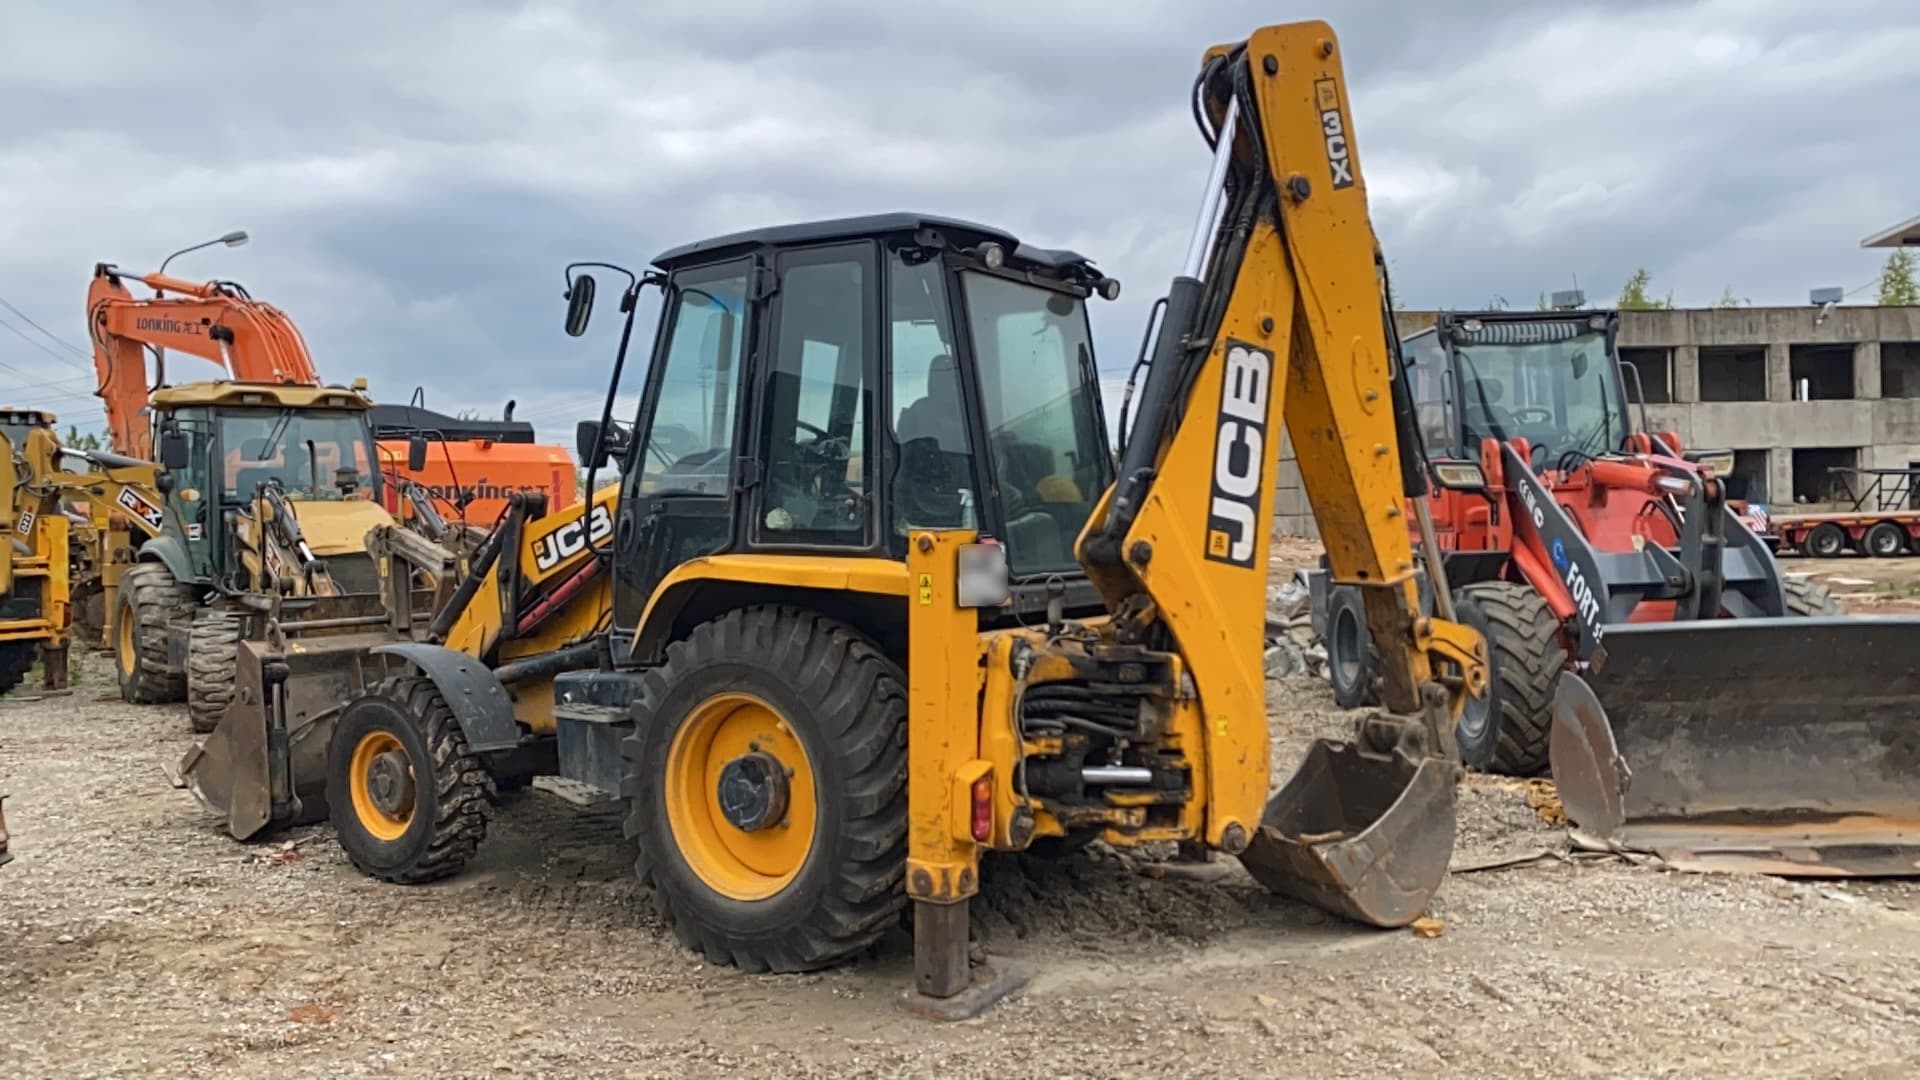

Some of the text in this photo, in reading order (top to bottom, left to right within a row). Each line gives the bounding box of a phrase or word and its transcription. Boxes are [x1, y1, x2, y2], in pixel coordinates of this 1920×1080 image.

[1322, 110, 1353, 185] 3CX
[1212, 346, 1270, 562] JCB
[121, 489, 162, 528] RMX
[535, 505, 613, 570] JCB
[1566, 561, 1600, 627] FORT
